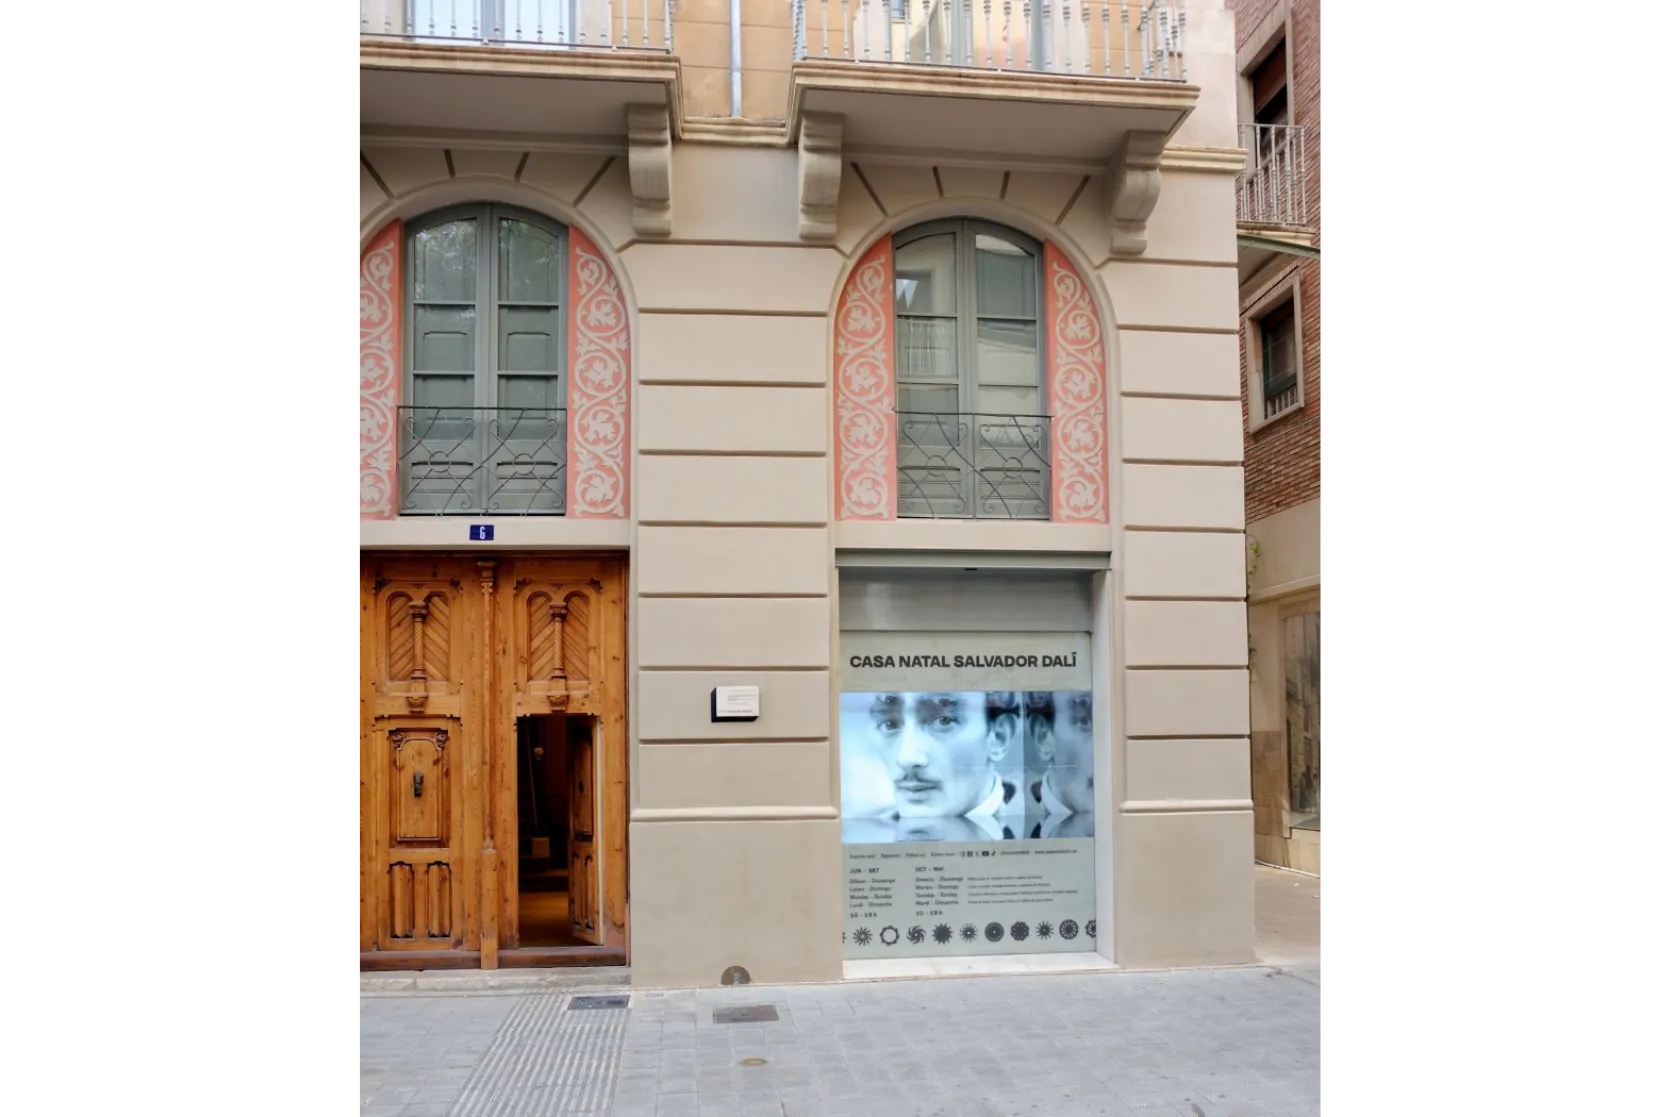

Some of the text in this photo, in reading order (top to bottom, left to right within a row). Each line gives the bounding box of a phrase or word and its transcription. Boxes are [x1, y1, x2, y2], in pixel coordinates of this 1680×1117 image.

[480, 526, 486, 540] 6
[850, 651, 1077, 668] CASA NATAL SALVADOR DALÍ
